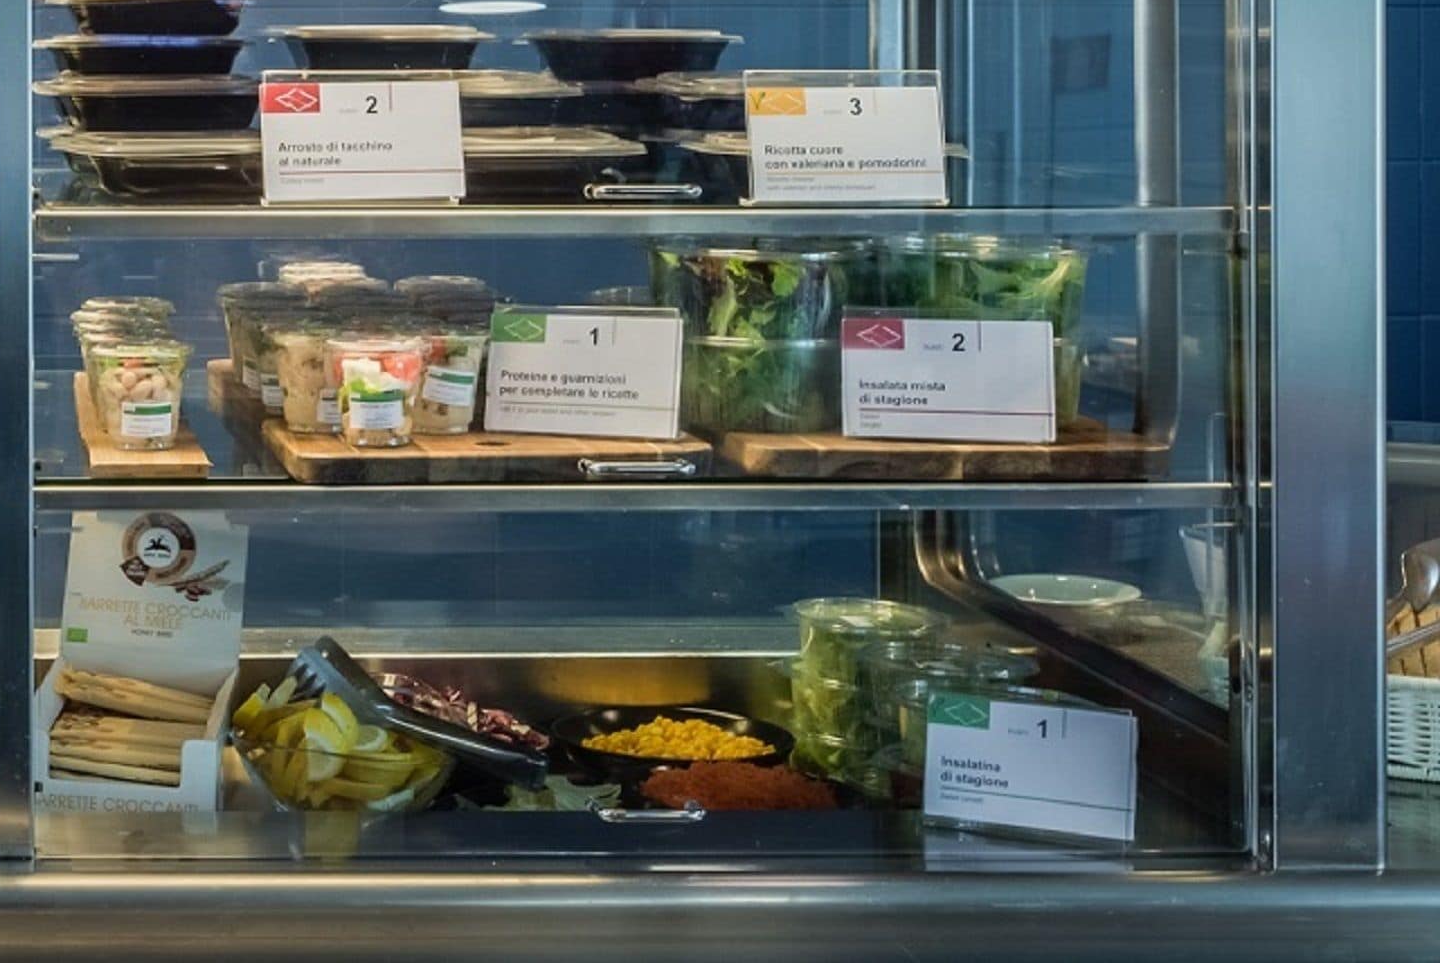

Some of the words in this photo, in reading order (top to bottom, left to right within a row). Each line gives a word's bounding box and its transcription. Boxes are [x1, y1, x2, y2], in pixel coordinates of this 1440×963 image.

[366, 96, 378, 114] 2
[850, 98, 862, 115] 3
[279, 142, 323, 152] Arrosto
[326, 141, 338, 151] di
[341, 141, 392, 151] tacchino
[764, 145, 806, 155] Ricotta
[810, 146, 843, 155] cuore
[279, 157, 288, 166] al
[293, 156, 341, 166] naturale
[765, 161, 788, 169] con
[791, 159, 844, 169] valeriana
[859, 158, 927, 170] pomodorini
[589, 328, 599, 345] 1
[952, 333, 965, 352] 2
[501, 370, 548, 382] Proteine
[551, 374, 557, 382] e
[561, 373, 626, 386] guarnizioni
[859, 380, 908, 390] Insalata
[911, 381, 945, 391] mista
[499, 387, 518, 397] per
[521, 387, 585, 400] completare
[859, 394, 871, 404] di
[874, 394, 928, 406] stagione
[144, 602, 232, 621] CROCCANTI
[1037, 720, 1047, 738] 1
[940, 756, 1001, 772] Insalatina
[940, 771, 953, 782] di
[955, 772, 1008, 788] stagione
